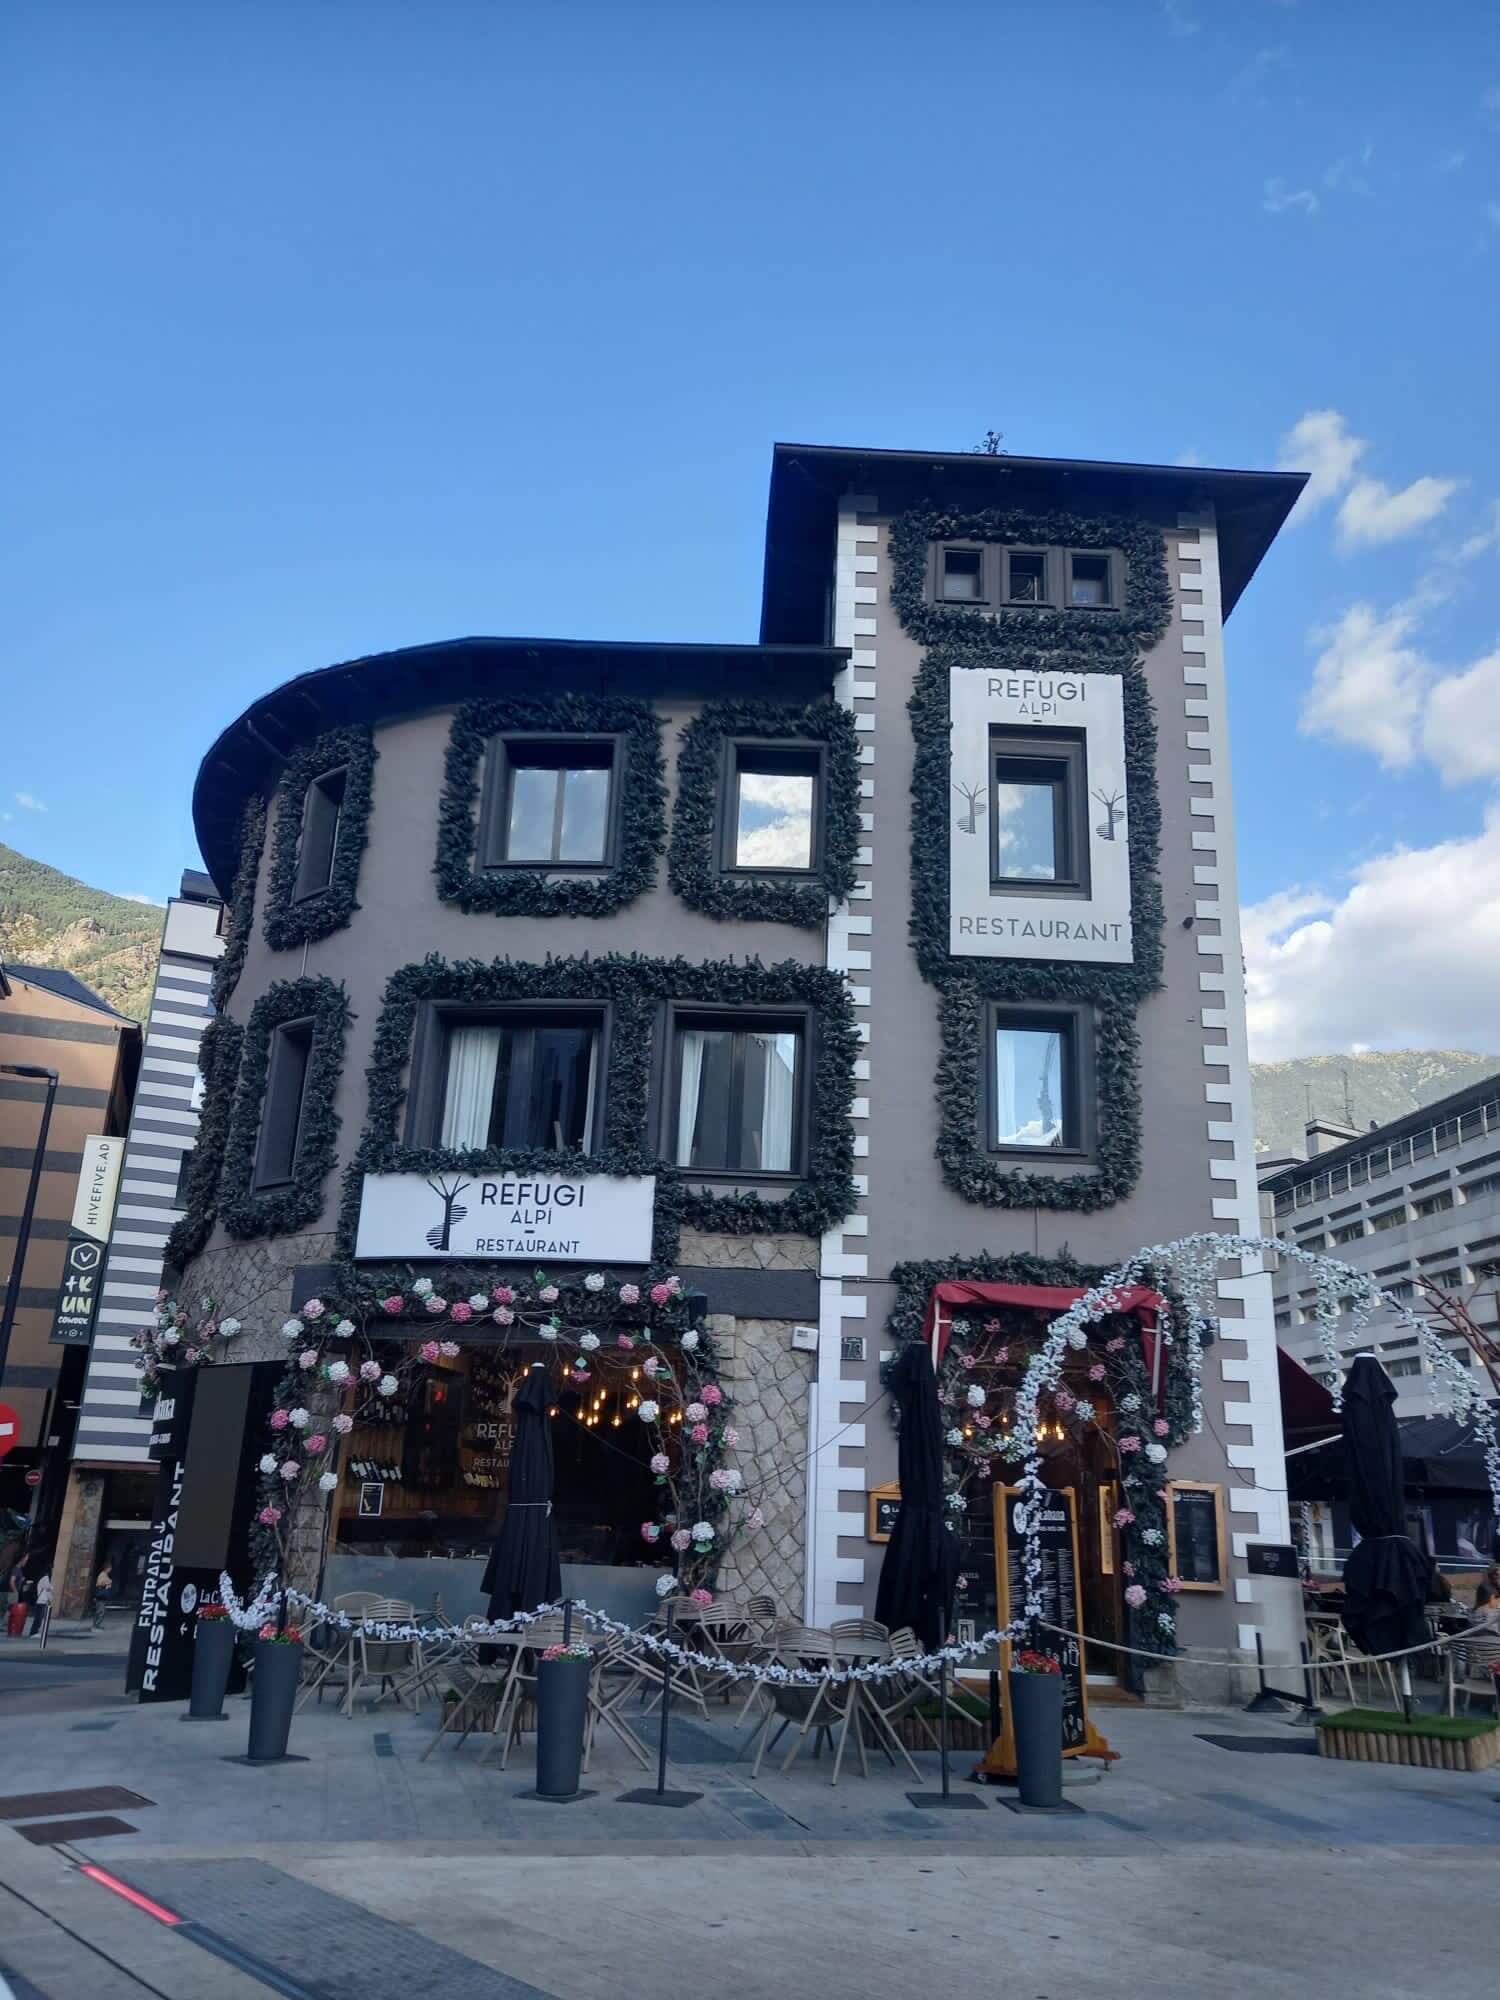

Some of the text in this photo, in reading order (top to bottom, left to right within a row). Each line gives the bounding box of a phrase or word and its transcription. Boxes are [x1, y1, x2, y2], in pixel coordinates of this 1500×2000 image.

[987, 678, 1086, 702] REFUGI
[958, 916, 1123, 942] RESTAURANT
[87, 1142, 110, 1225] HIVEFIVE.AD
[480, 1182, 585, 1207] REFUGI
[476, 1238, 580, 1254] RESTAURANT
[476, 1423, 517, 1439] REFU
[473, 1458, 510, 1468] RESTAU
